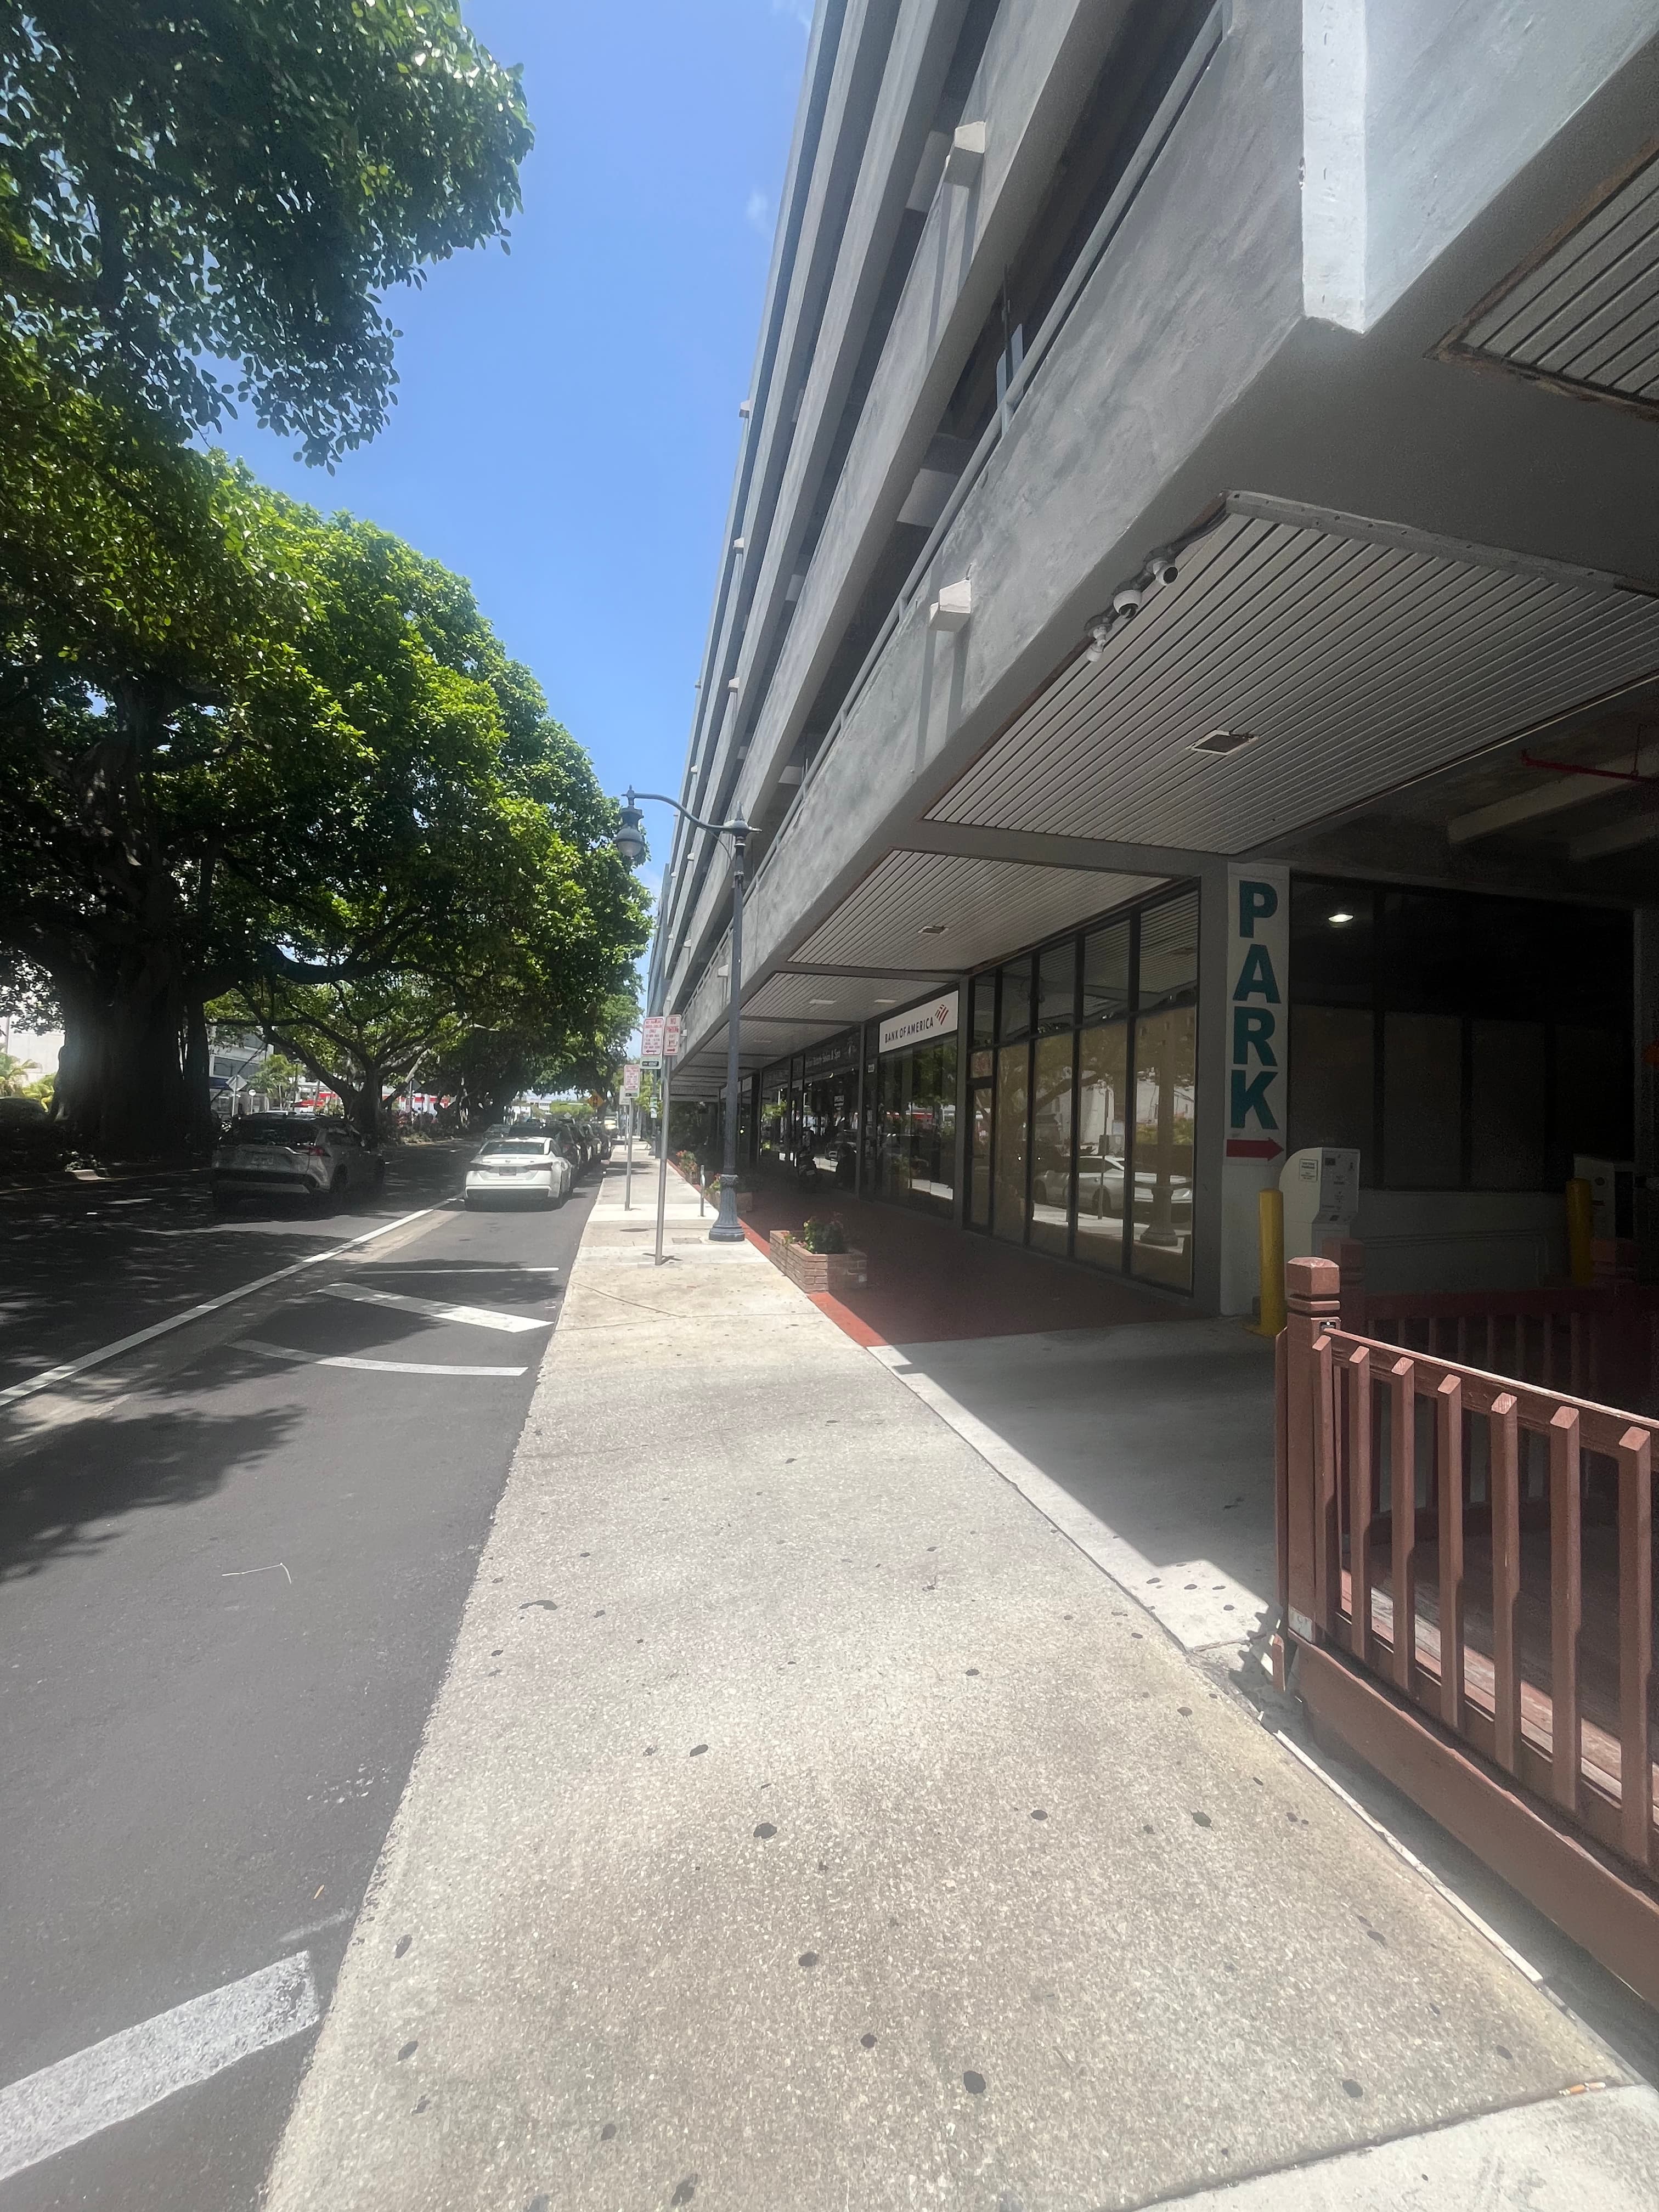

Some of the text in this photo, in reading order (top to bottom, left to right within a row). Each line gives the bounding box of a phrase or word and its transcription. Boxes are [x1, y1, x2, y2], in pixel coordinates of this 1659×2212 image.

[885, 1017, 933, 1043] BANK OF AMERICA
[1231, 880, 1282, 1129] PARK
